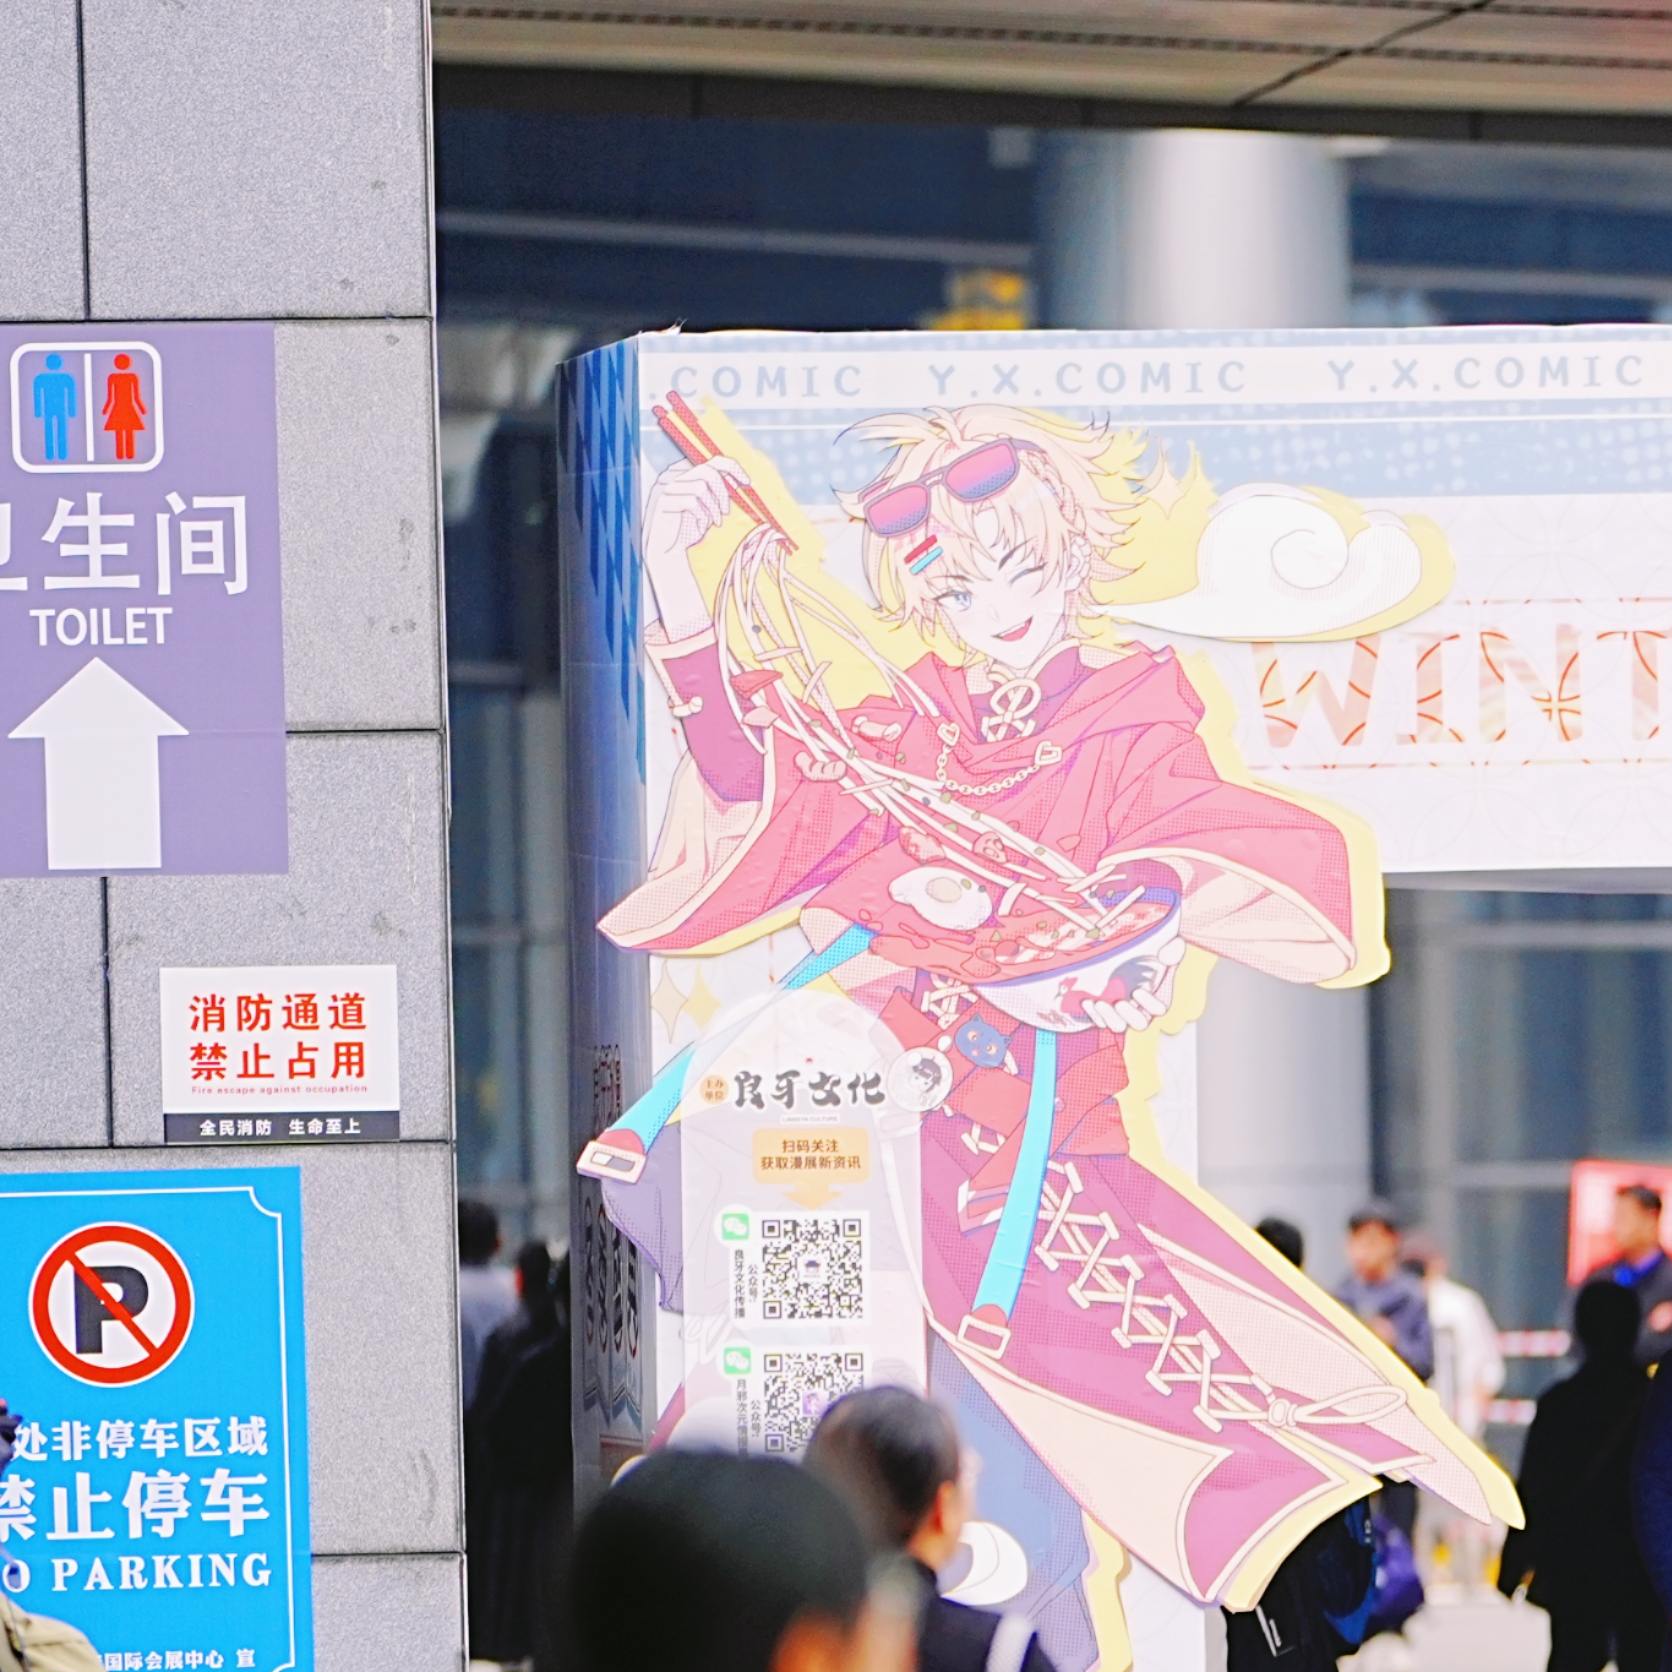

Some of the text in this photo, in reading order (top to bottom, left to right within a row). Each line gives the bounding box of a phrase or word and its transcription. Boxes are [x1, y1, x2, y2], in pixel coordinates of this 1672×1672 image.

[929, 360, 1246, 399] Y.X.COMIC
[1328, 354, 1644, 394] Y.X.COMIC
[29, 607, 174, 647] TOILET
[189, 992, 367, 1033] 消防通道
[190, 1041, 366, 1081] 禁止占用
[734, 1069, 886, 1109] 良牙文化
[200, 1118, 361, 1136] 全民消防 生命至上
[781, 1138, 839, 1153] 扫码关注
[760, 1155, 861, 1170] 获取漫展新资讯
[2, 1553, 272, 1594] O PARKING
[98, 1648, 255, 1672] 国际会展中心 宣
